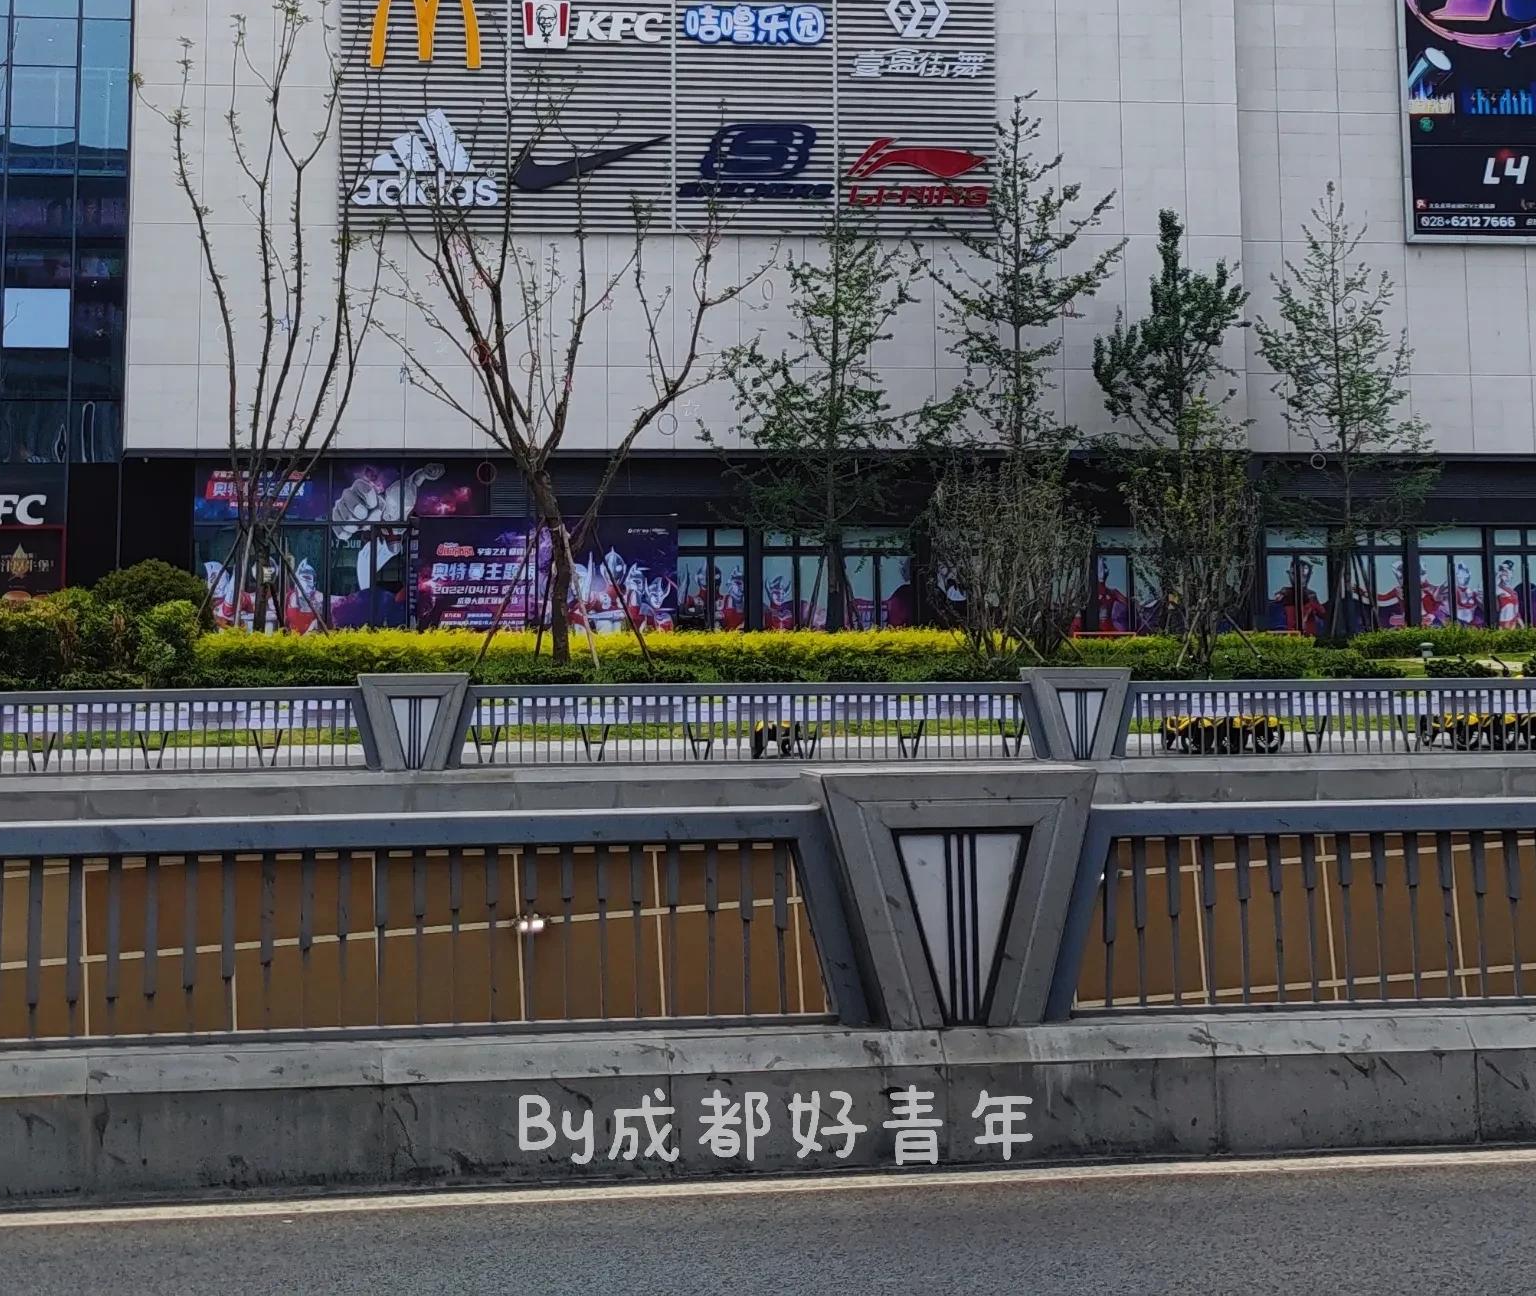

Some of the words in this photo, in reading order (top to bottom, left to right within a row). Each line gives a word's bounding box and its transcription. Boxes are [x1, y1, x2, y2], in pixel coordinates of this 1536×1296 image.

[572, 10, 664, 42] KFC
[685, 4, 826, 45] 咕噜乐园
[1482, 155, 1530, 184] L4
[350, 170, 498, 206] adidas
[847, 185, 989, 207] LI-NING
[433, 585, 499, 594] 2022/04/15
